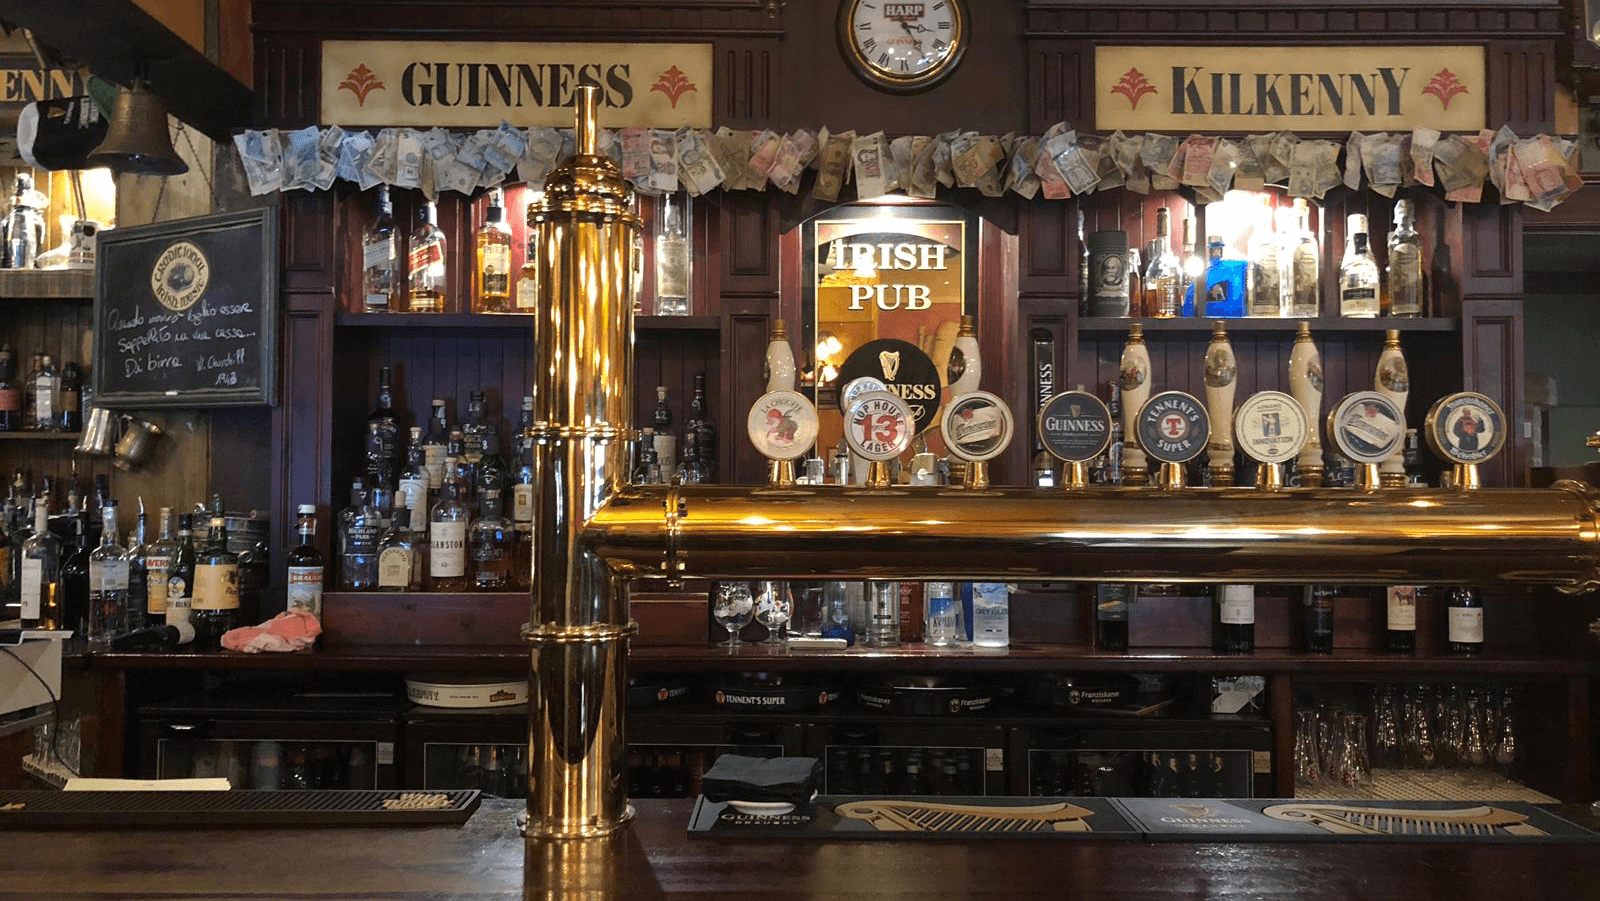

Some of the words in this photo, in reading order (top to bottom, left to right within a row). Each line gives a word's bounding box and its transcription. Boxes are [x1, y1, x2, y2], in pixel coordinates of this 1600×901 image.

[885, 4, 923, 16] HARP
[401, 62, 634, 108] GUINNESS
[1170, 66, 1411, 116] KILKENNY
[832, 243, 947, 271] IRISH
[848, 284, 932, 310] PUB
[125, 357, 143, 378] Di
[853, 405, 869, 425] HOP
[874, 401, 905, 426] HOUSE
[1147, 400, 1200, 423] TENNENT'S
[858, 414, 898, 442] 13
[1046, 417, 1105, 432] GUINNESS
[1166, 418, 1181, 436] T
[861, 439, 897, 453] LAGER
[1157, 439, 1192, 453] SUPER
[726, 694, 762, 705] TENNENT'S
[762, 696, 785, 705] SUPER
[721, 813, 811, 821] GUINNESS
